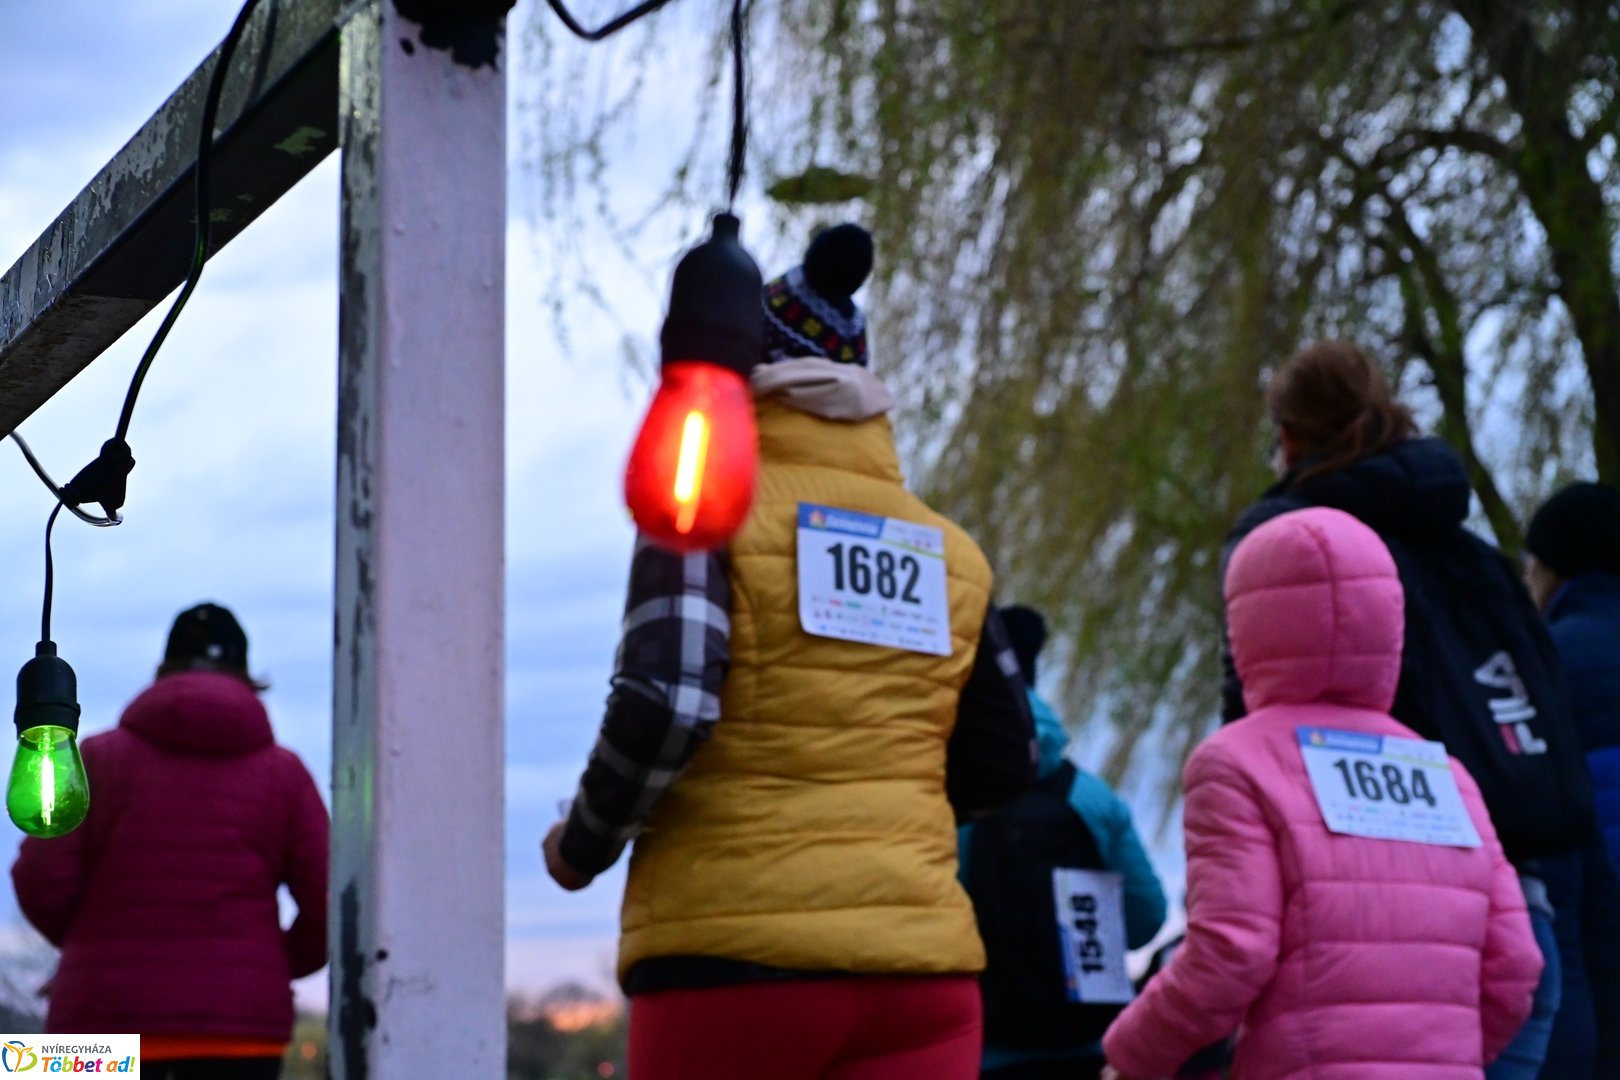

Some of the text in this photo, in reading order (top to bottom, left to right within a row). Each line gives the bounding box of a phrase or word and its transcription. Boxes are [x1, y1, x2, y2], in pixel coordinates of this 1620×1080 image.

[826, 542, 922, 605] 1682
[1473, 650, 1547, 755] FILA
[1333, 758, 1437, 808] 1684
[1071, 894, 1104, 973] 1548
